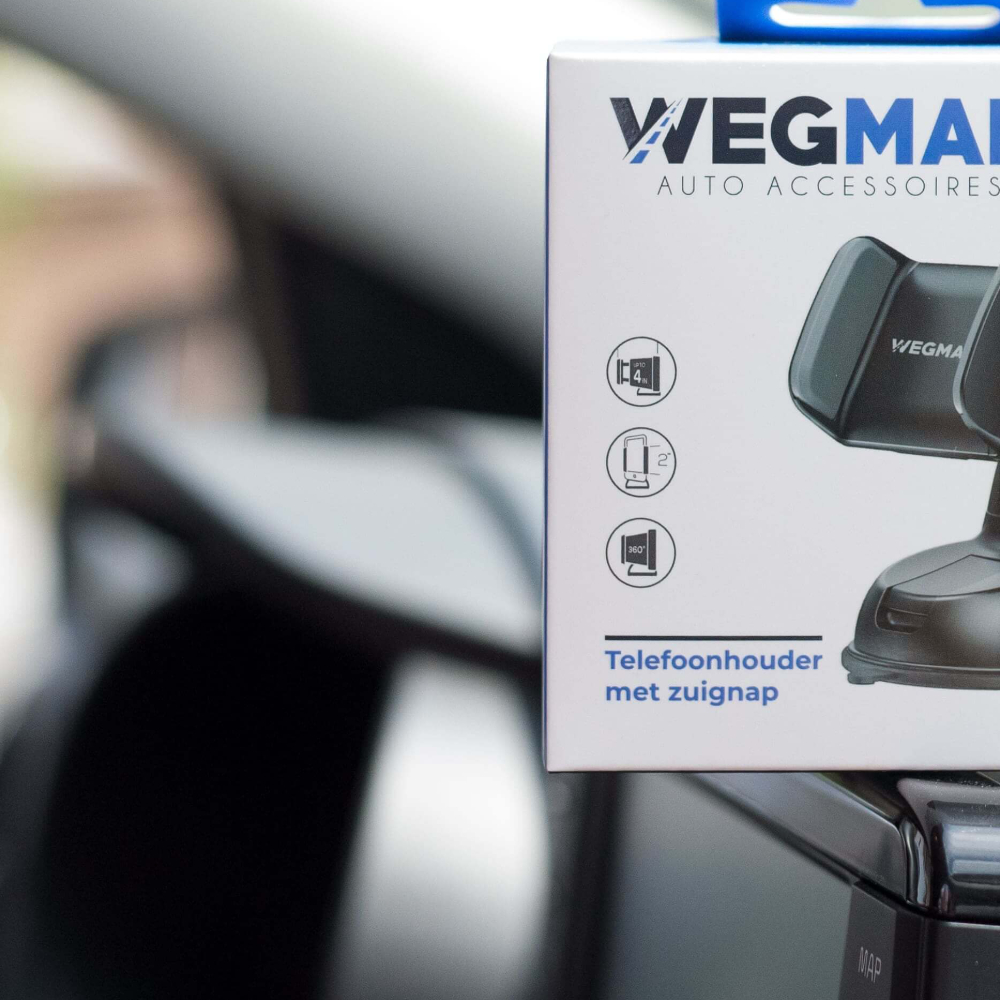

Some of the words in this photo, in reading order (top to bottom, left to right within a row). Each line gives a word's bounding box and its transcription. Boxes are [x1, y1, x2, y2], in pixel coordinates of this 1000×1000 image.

[657, 175, 744, 196] AUTO
[892, 338, 964, 359] WEGMA
[605, 649, 823, 670] Telefoonhouder
[606, 683, 660, 701] met
[668, 680, 779, 706] zuignap
[858, 946, 882, 983] MAP
